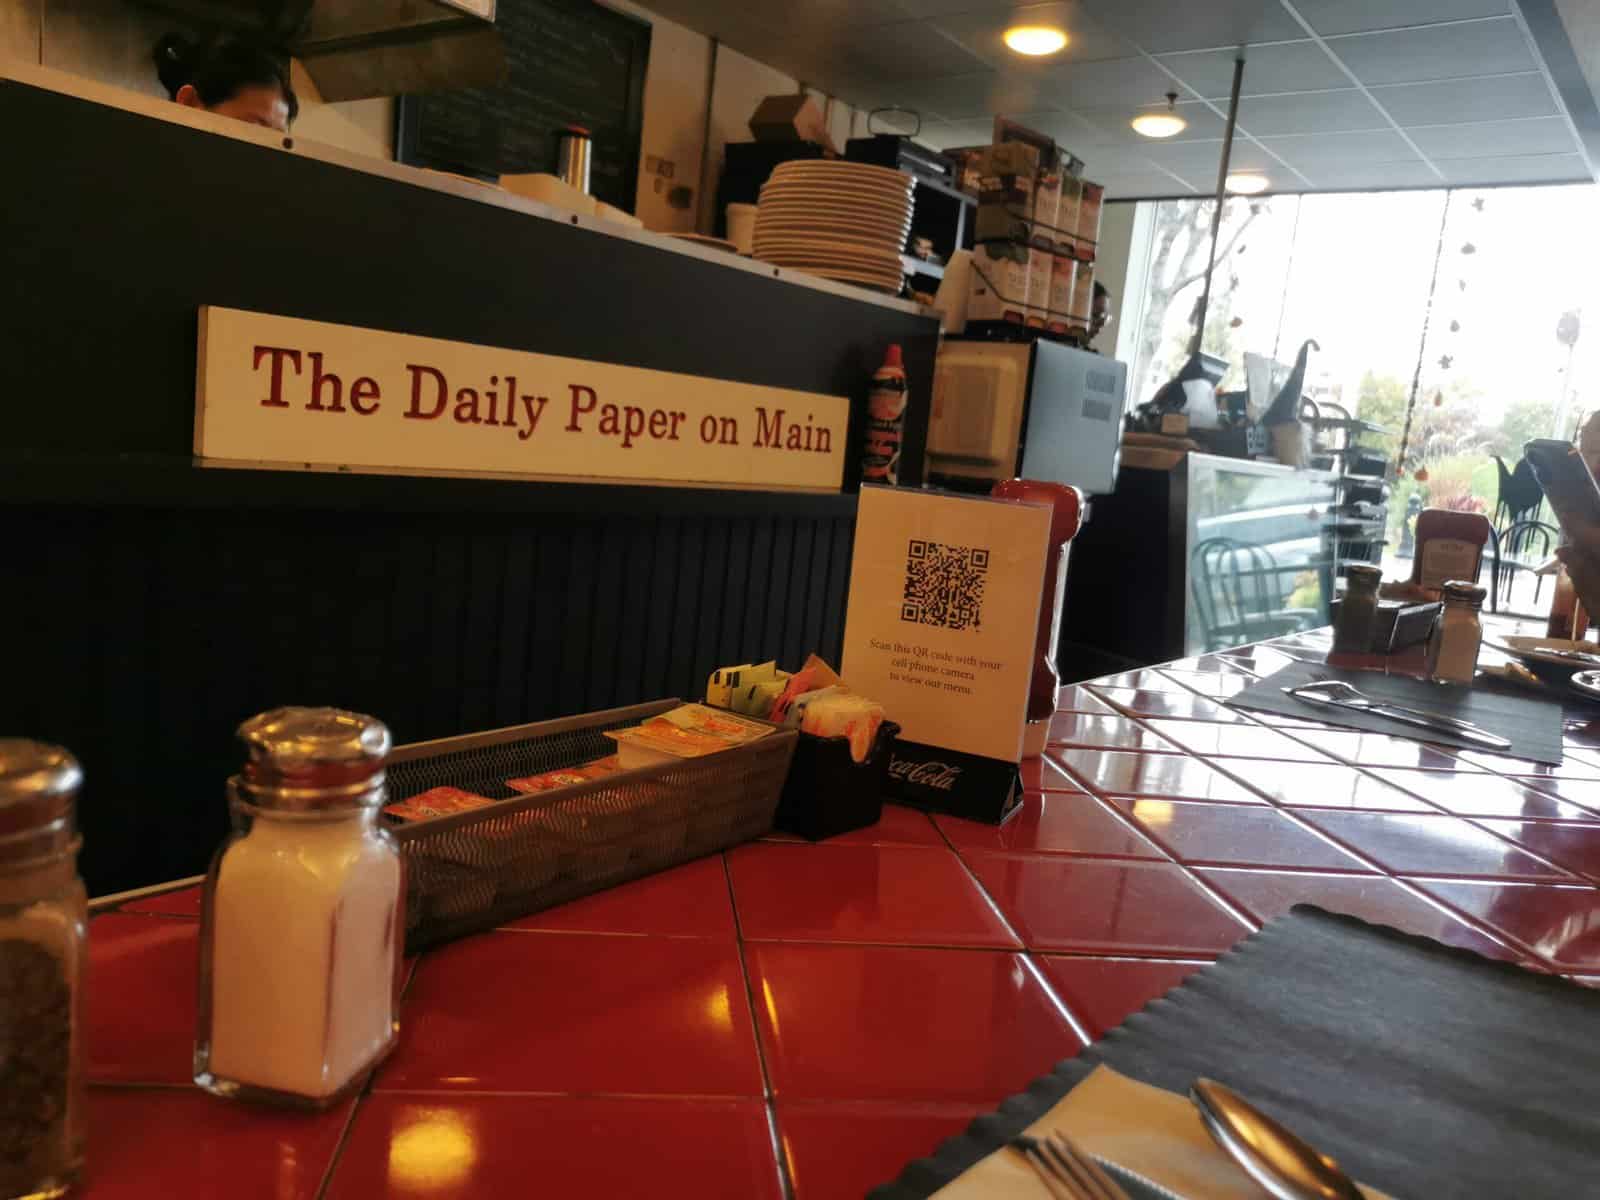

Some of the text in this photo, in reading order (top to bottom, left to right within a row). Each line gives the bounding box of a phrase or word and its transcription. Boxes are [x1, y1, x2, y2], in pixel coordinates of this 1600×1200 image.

[252, 345, 833, 454] The Daily Paper on Main
[869, 638, 1004, 673] Scan this QR code with your
[891, 657, 976, 681] cell phone camera
[889, 671, 900, 682] to
[900, 674, 923, 685] view
[924, 678, 941, 690] our
